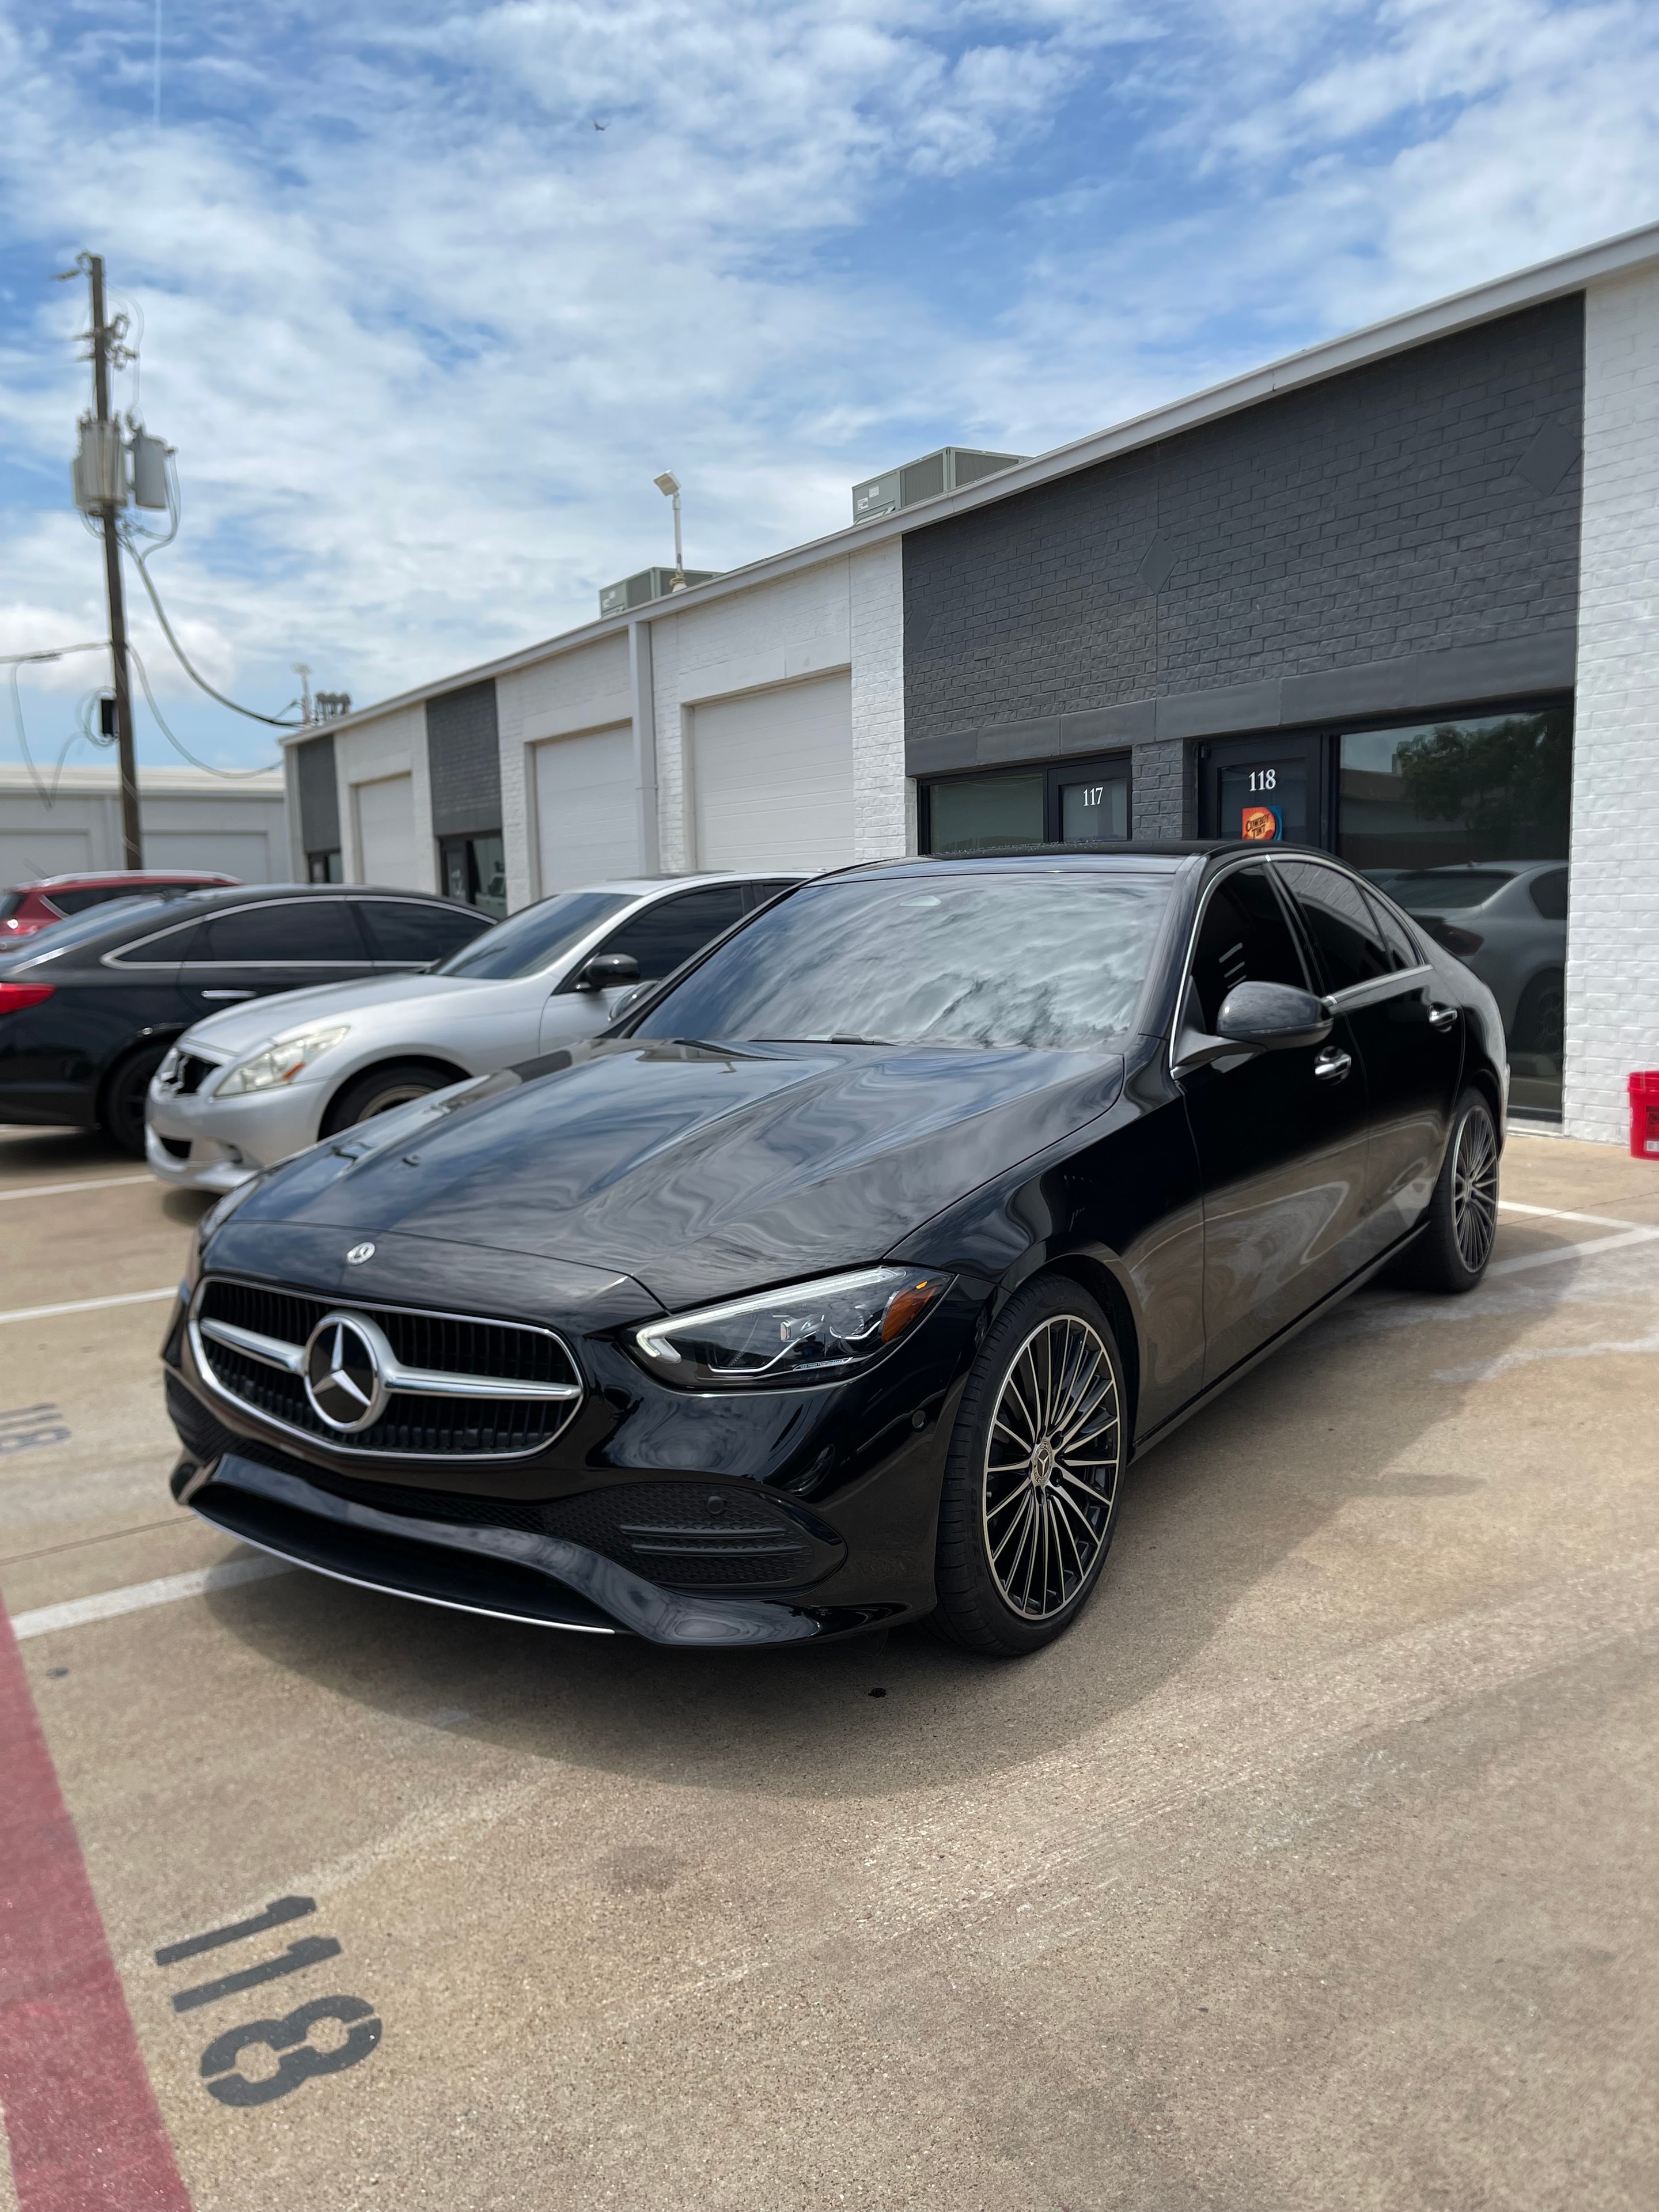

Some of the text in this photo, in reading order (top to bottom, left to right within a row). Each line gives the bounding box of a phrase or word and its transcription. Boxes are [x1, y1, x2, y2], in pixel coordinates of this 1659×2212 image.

[1248, 768, 1277, 792] 118
[1083, 786, 1104, 807] 117
[1246, 814, 1269, 832] COWBOY
[1252, 824, 1266, 839] TINT
[154, 1895, 382, 2107] 118
